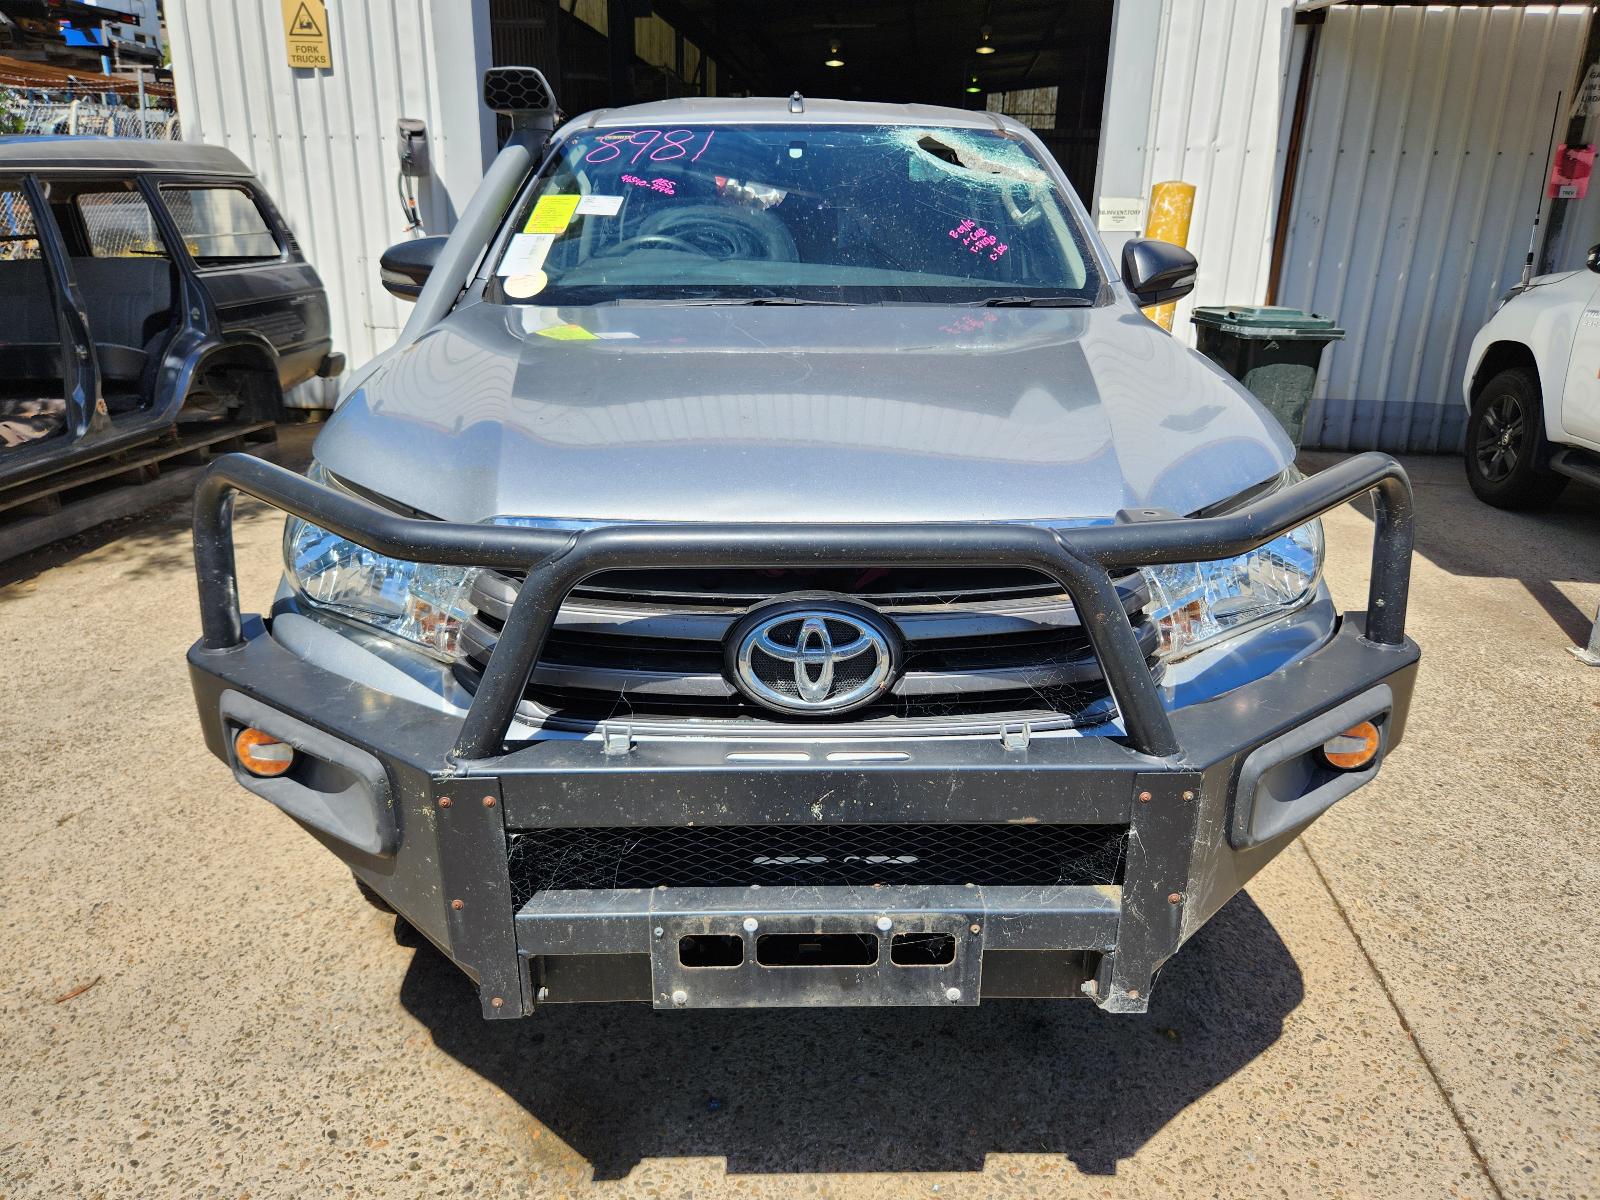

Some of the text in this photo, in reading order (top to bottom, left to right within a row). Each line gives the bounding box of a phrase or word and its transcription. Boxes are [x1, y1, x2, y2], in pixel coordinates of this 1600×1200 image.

[295, 46, 319, 54] FORK
[291, 55, 326, 64] TRUCKS
[586, 130, 715, 164] 8981
